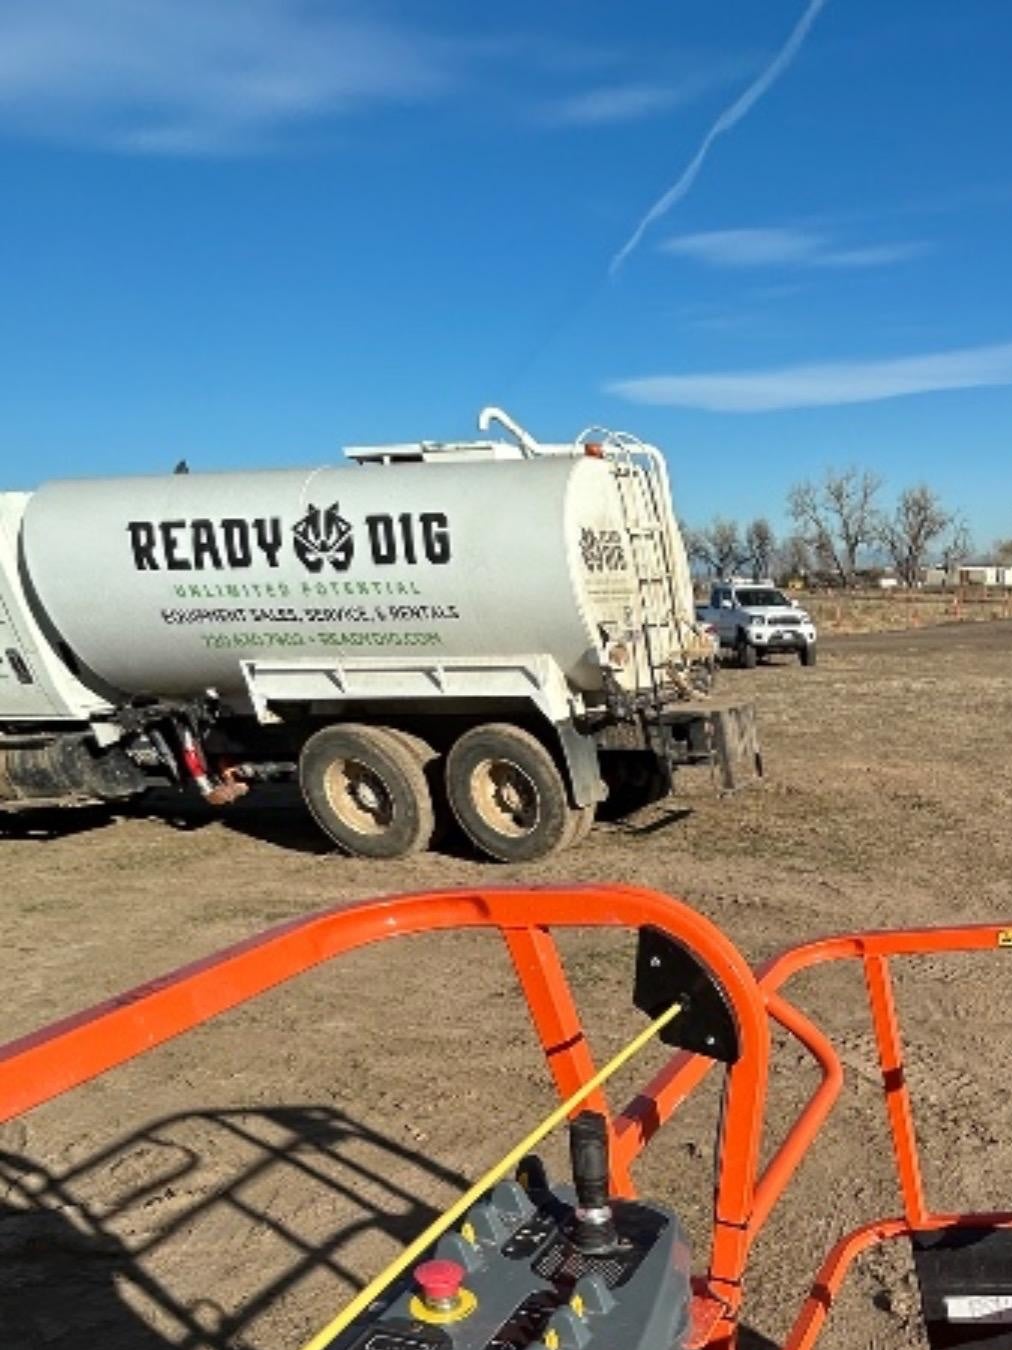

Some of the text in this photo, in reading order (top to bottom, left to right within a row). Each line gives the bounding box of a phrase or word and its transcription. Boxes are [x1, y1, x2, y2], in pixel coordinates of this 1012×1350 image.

[127, 512, 452, 571] READY DIG
[174, 580, 421, 599] UNLIMITED POTENTIAL
[161, 608, 247, 625] EQUIPMENT
[388, 604, 460, 620] RENTALS
